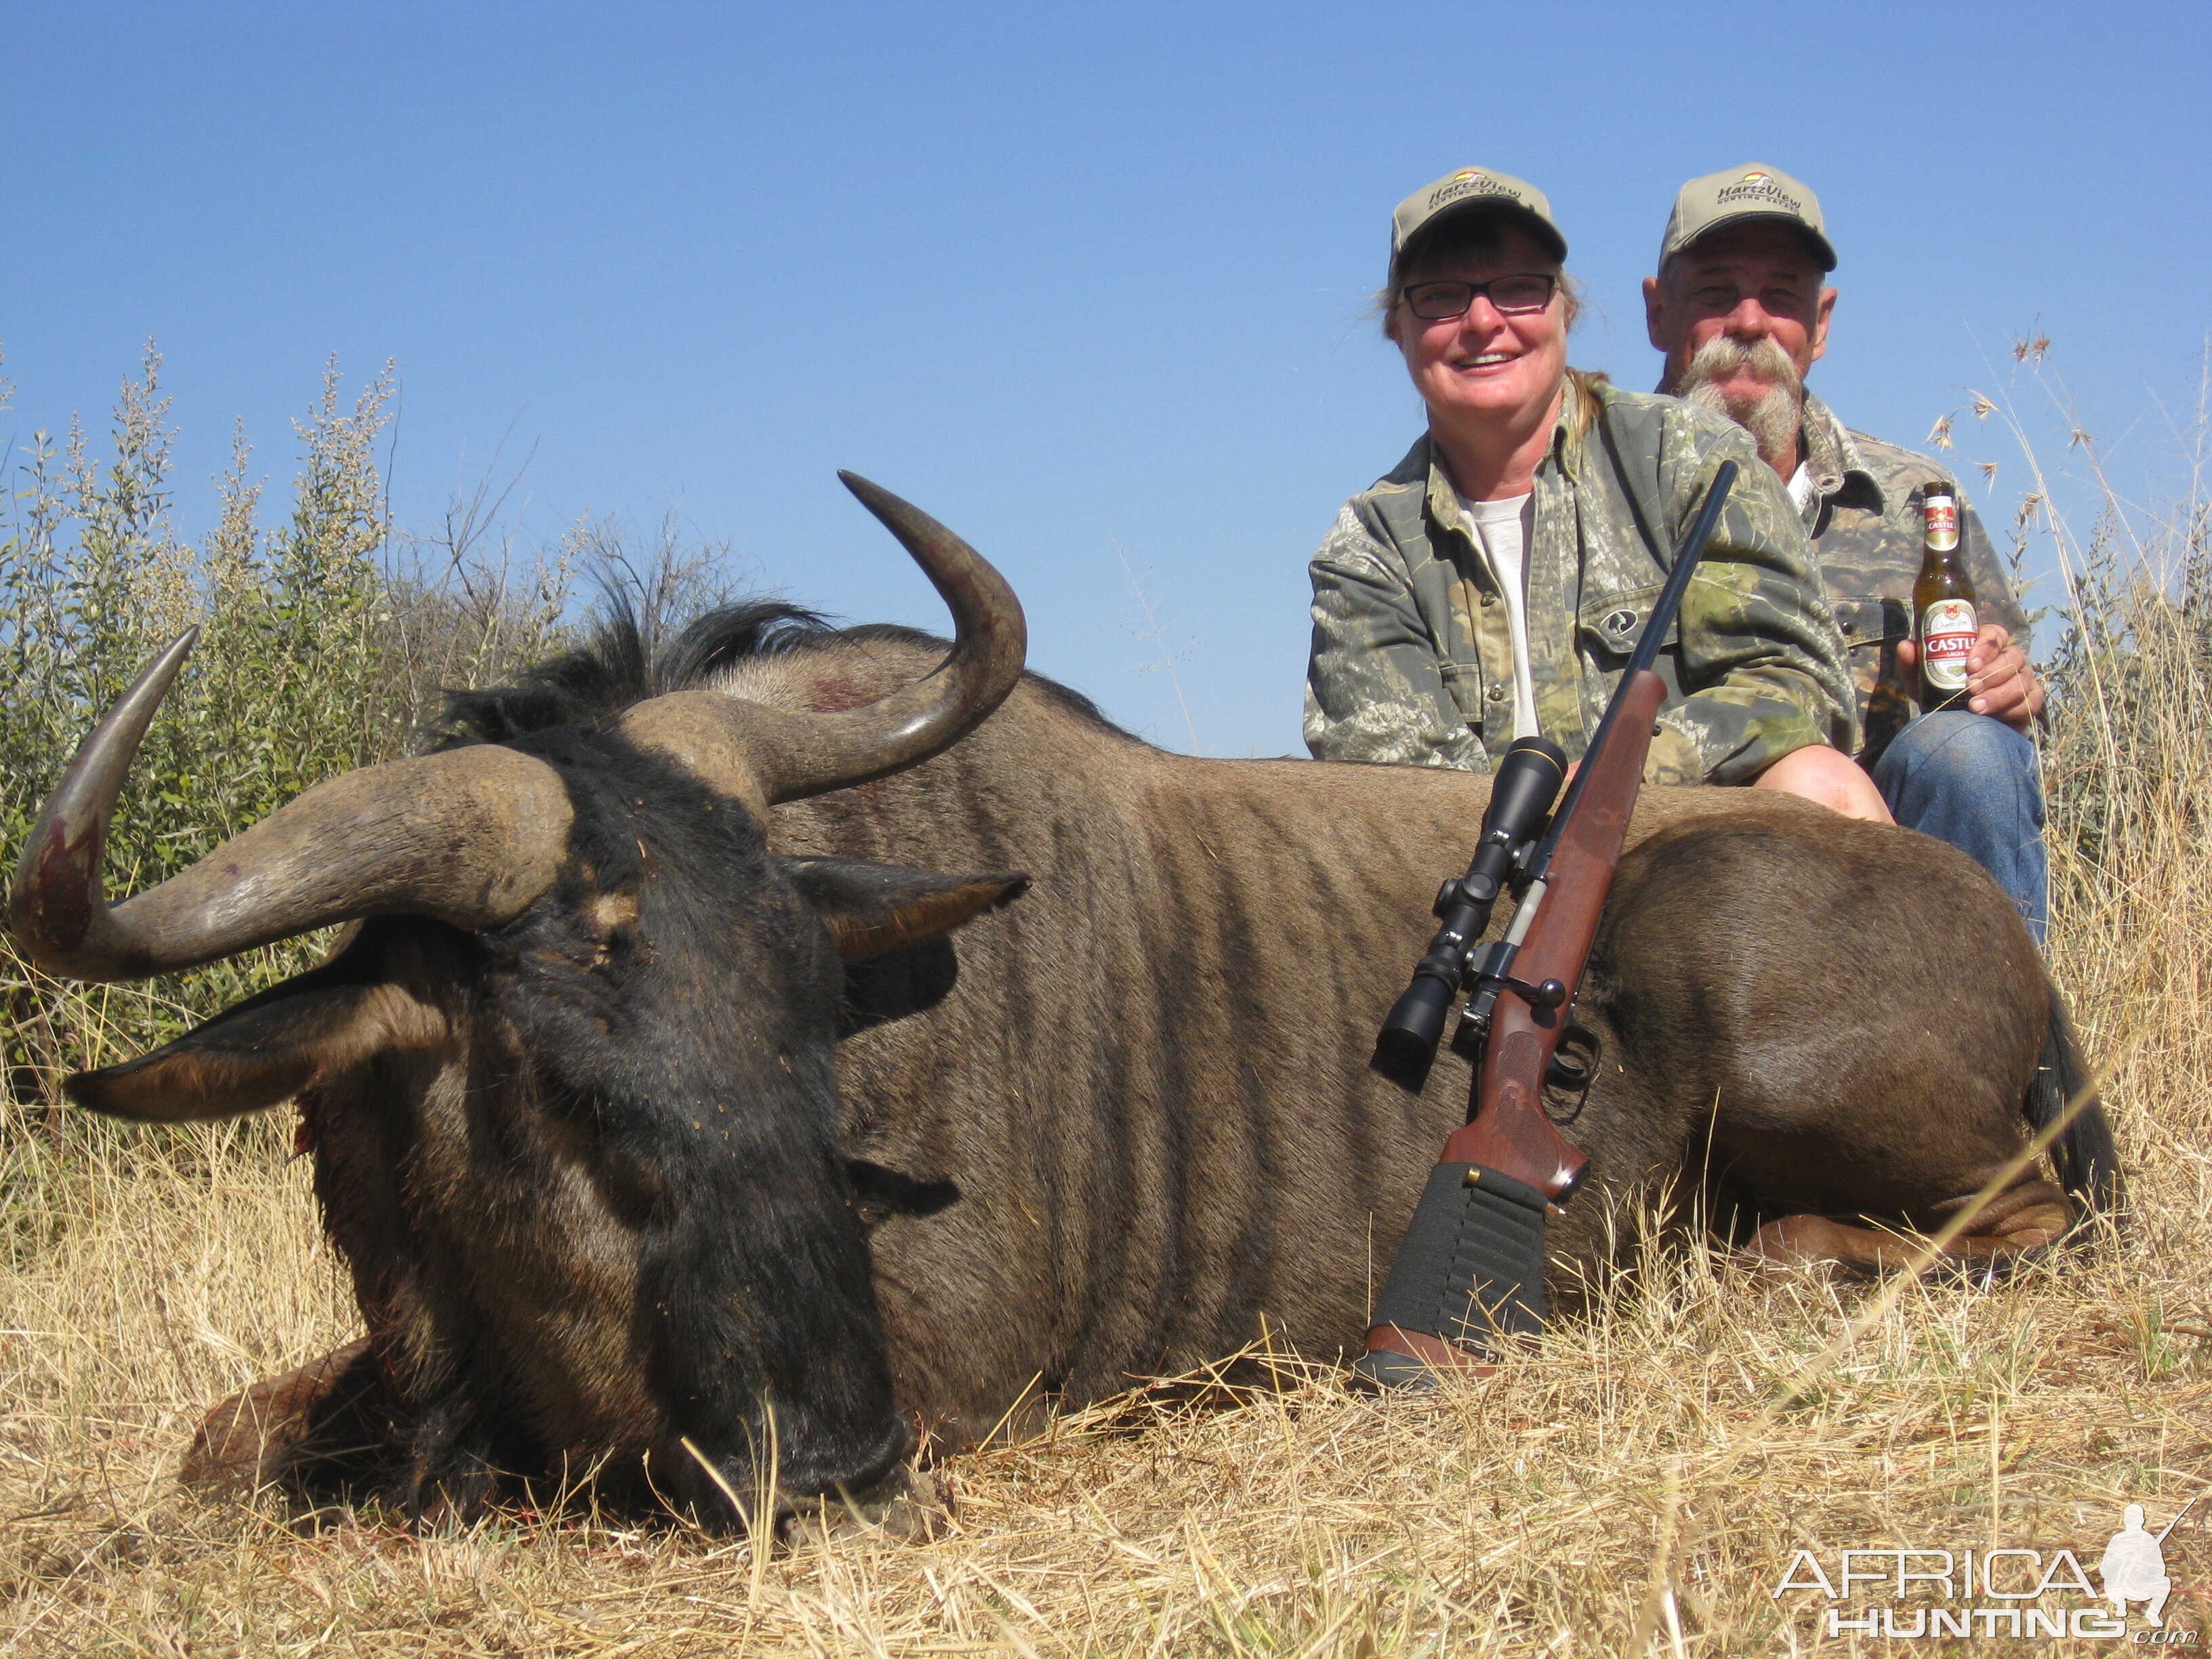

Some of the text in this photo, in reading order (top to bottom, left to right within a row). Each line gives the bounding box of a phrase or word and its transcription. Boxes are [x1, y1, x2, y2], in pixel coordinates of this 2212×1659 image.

[1429, 180, 1522, 204] HartzView
[1718, 184, 1801, 209] HartzView
[1928, 521, 1954, 529] CASTLE
